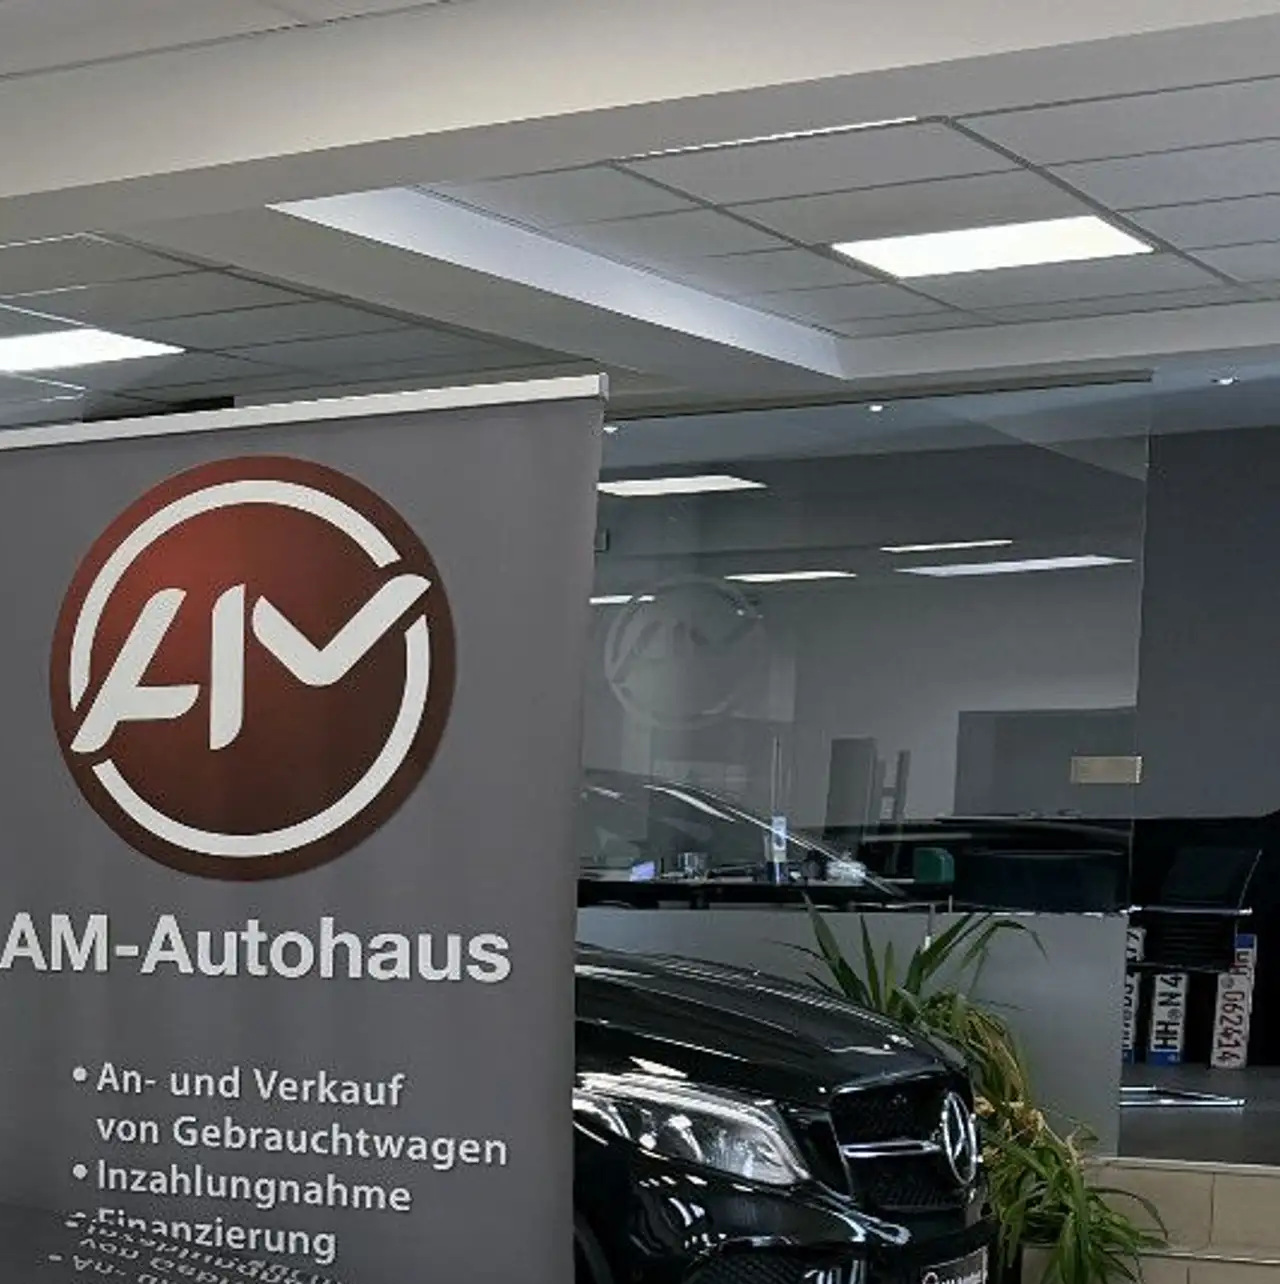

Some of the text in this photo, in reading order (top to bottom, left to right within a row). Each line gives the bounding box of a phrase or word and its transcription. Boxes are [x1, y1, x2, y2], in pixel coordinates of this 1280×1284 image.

[71, 573, 431, 753] AM
[1158, 991, 1182, 1008] N
[1153, 1019, 1180, 1050] HH
[96, 1062, 405, 1107] An- und Verkauf
[97, 1114, 508, 1171] von Gebrauchtwagen
[98, 1160, 413, 1213] Inzahlungnahme
